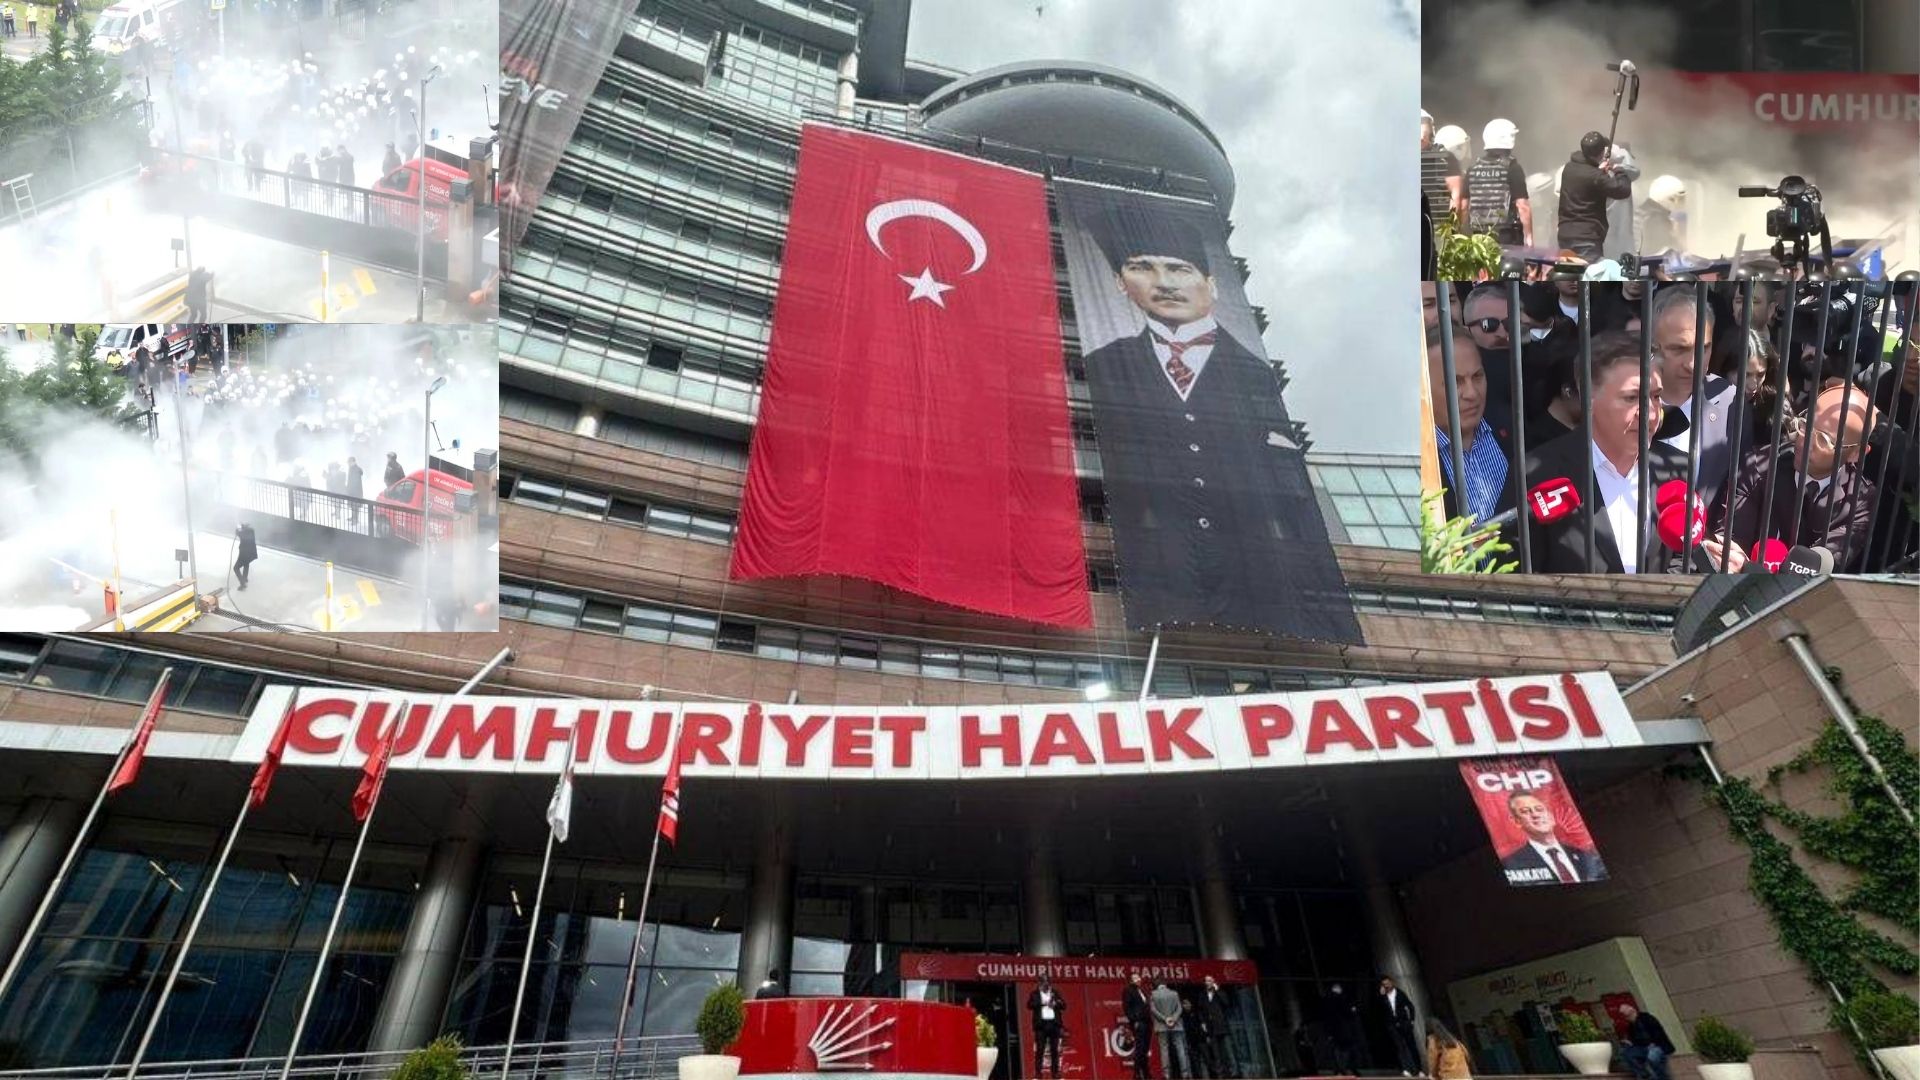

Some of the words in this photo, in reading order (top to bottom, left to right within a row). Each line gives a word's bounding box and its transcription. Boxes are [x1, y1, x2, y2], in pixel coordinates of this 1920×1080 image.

[1755, 93, 1920, 121] CUMHUR
[287, 698, 926, 768] CUMHURİYET
[960, 708, 1214, 767] HALK
[1240, 673, 1603, 757] PARTİSİ
[1476, 769, 1553, 792] CHP
[978, 960, 1079, 978] CUMHURİYET
[1085, 965, 1126, 979] HALK
